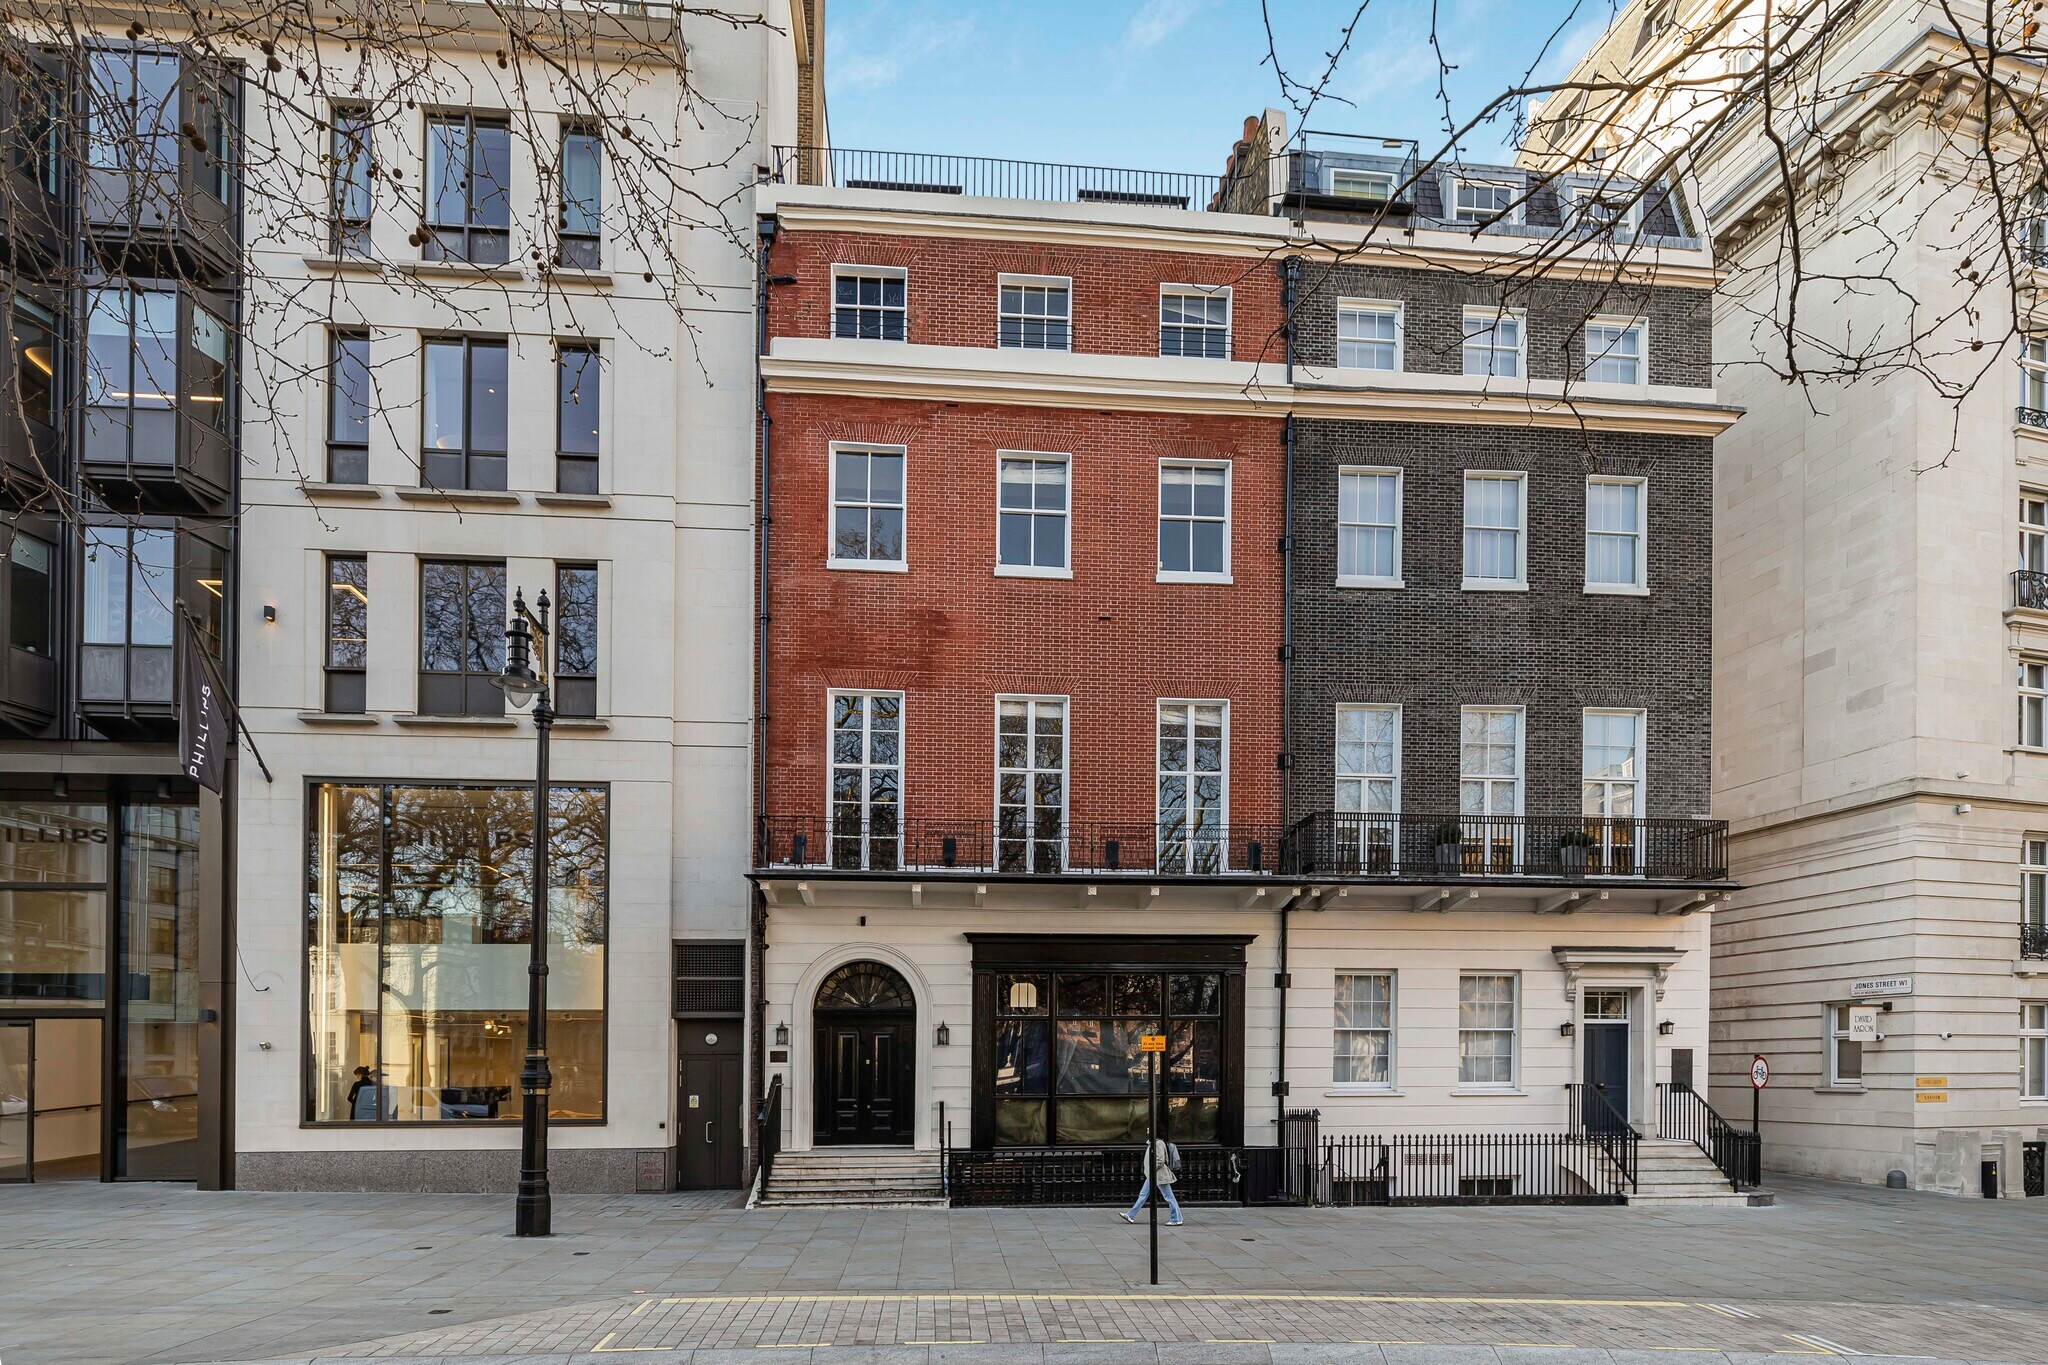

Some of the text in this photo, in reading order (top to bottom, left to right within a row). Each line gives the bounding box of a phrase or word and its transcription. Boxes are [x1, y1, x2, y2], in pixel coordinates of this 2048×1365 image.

[1854, 982, 1874, 990] JONES
[1854, 1015, 1873, 1023] DAVID
[1853, 1025, 1874, 1033] AARON
